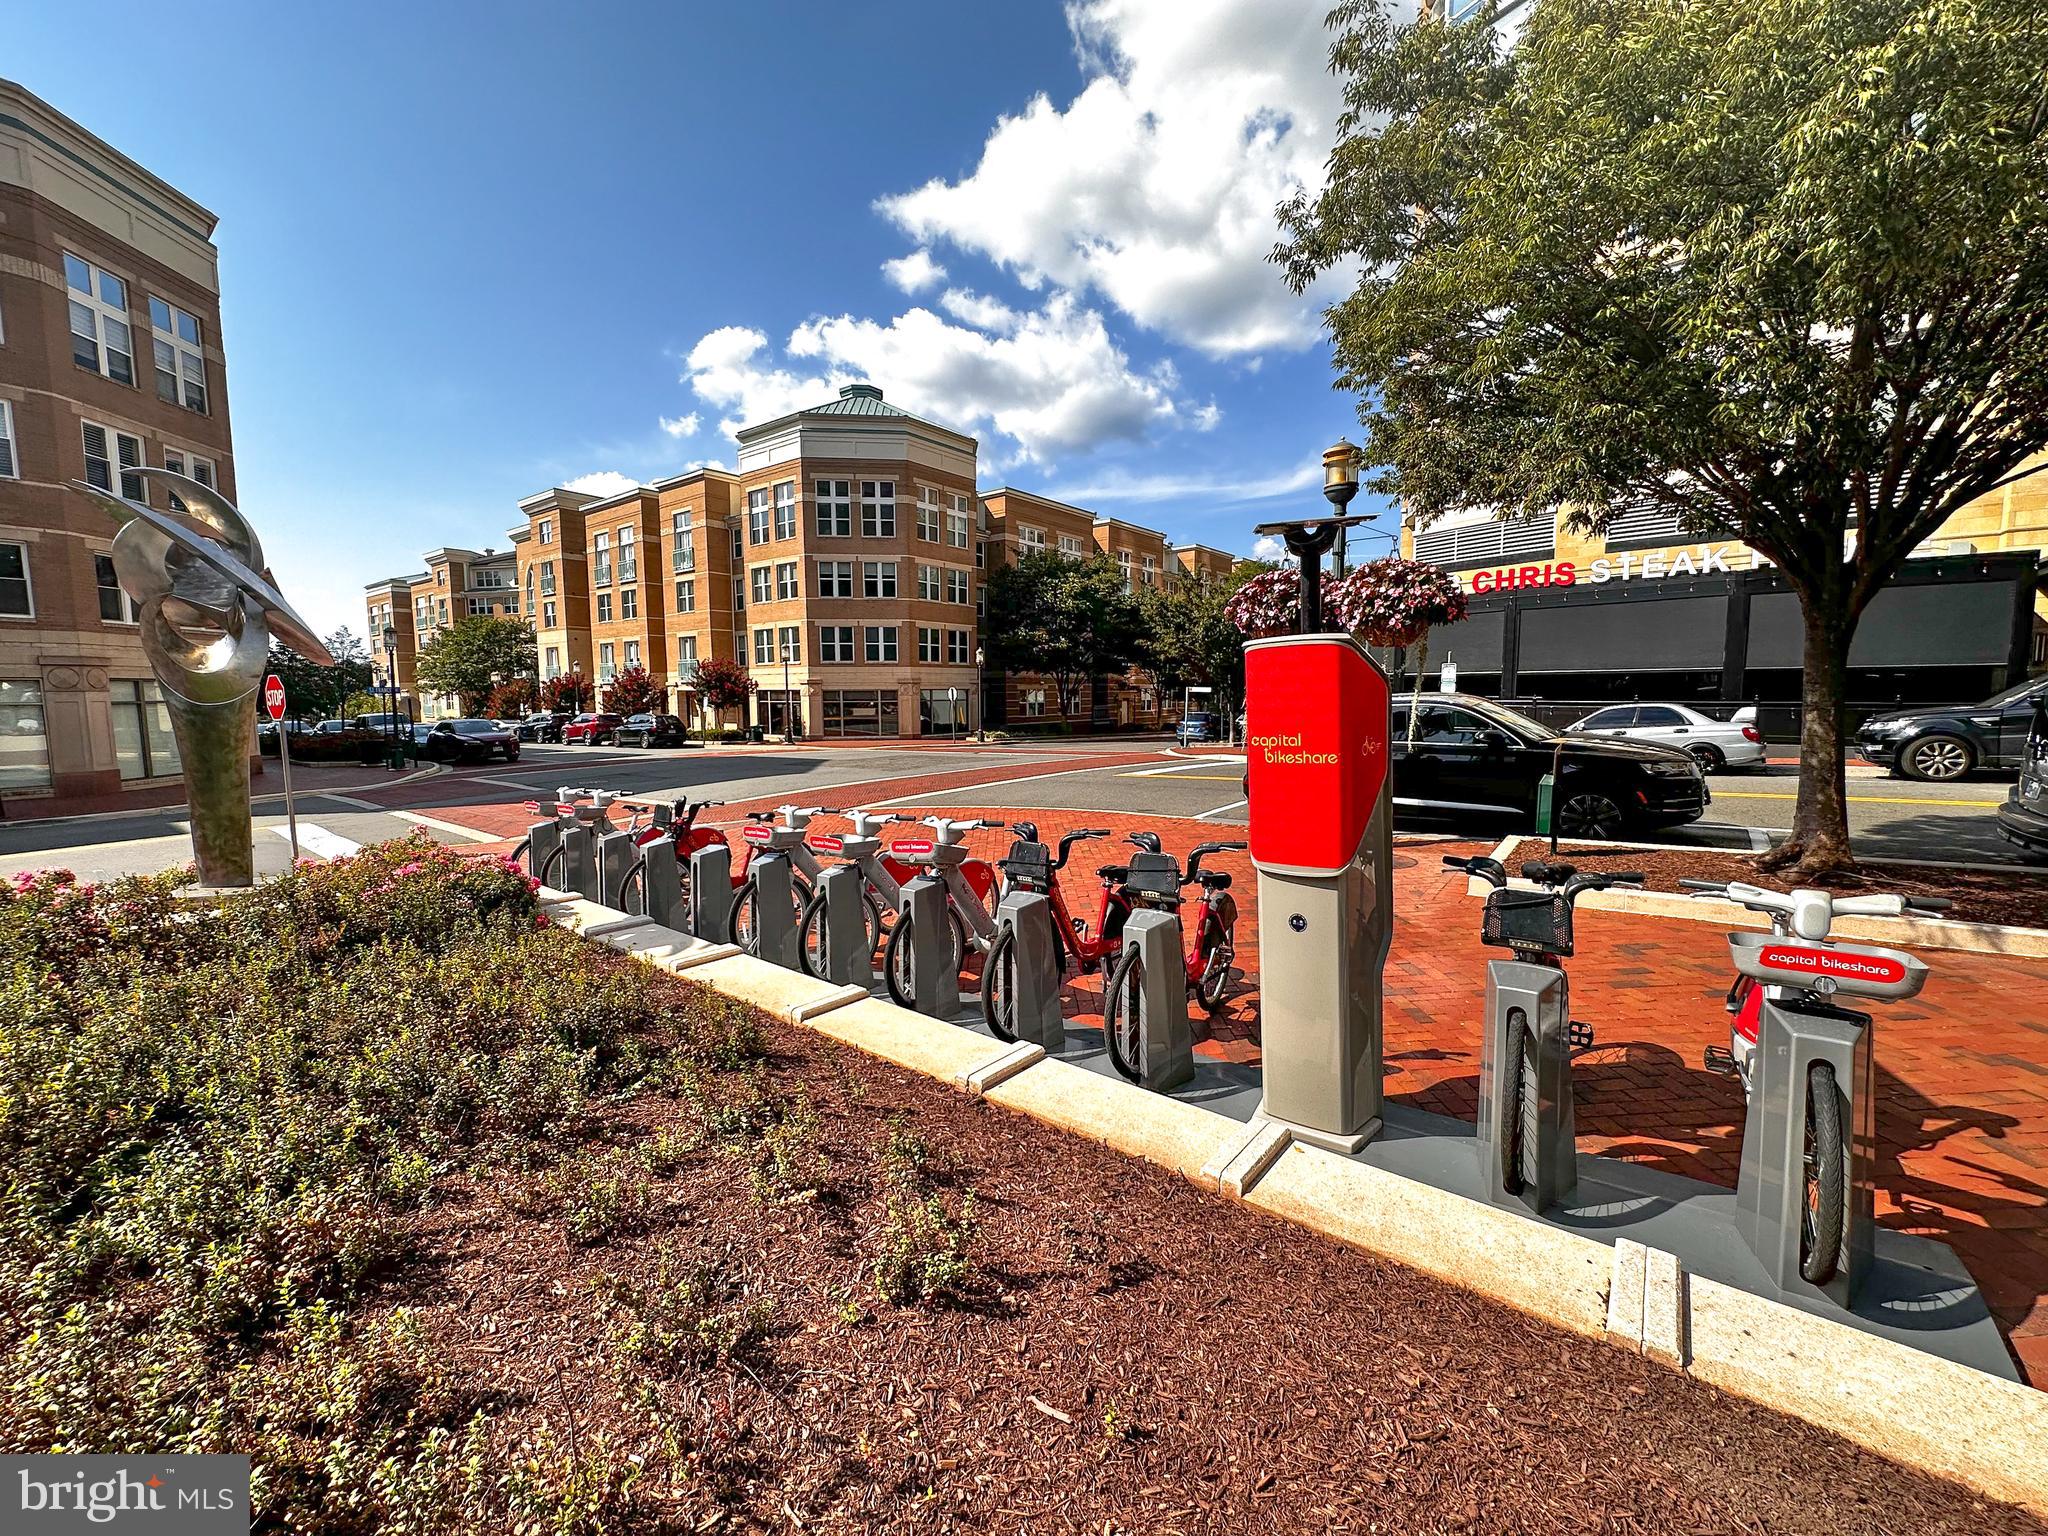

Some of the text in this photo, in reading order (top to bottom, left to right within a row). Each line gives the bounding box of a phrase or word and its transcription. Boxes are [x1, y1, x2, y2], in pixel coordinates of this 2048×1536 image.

[1472, 562, 1576, 594] CHRIS
[1589, 546, 1730, 584] STEAK
[267, 690, 283, 706] STOP
[1251, 733, 1301, 749] capital
[1264, 748, 1338, 764] bikeshare
[1769, 954, 1890, 976] capital bikeshare
